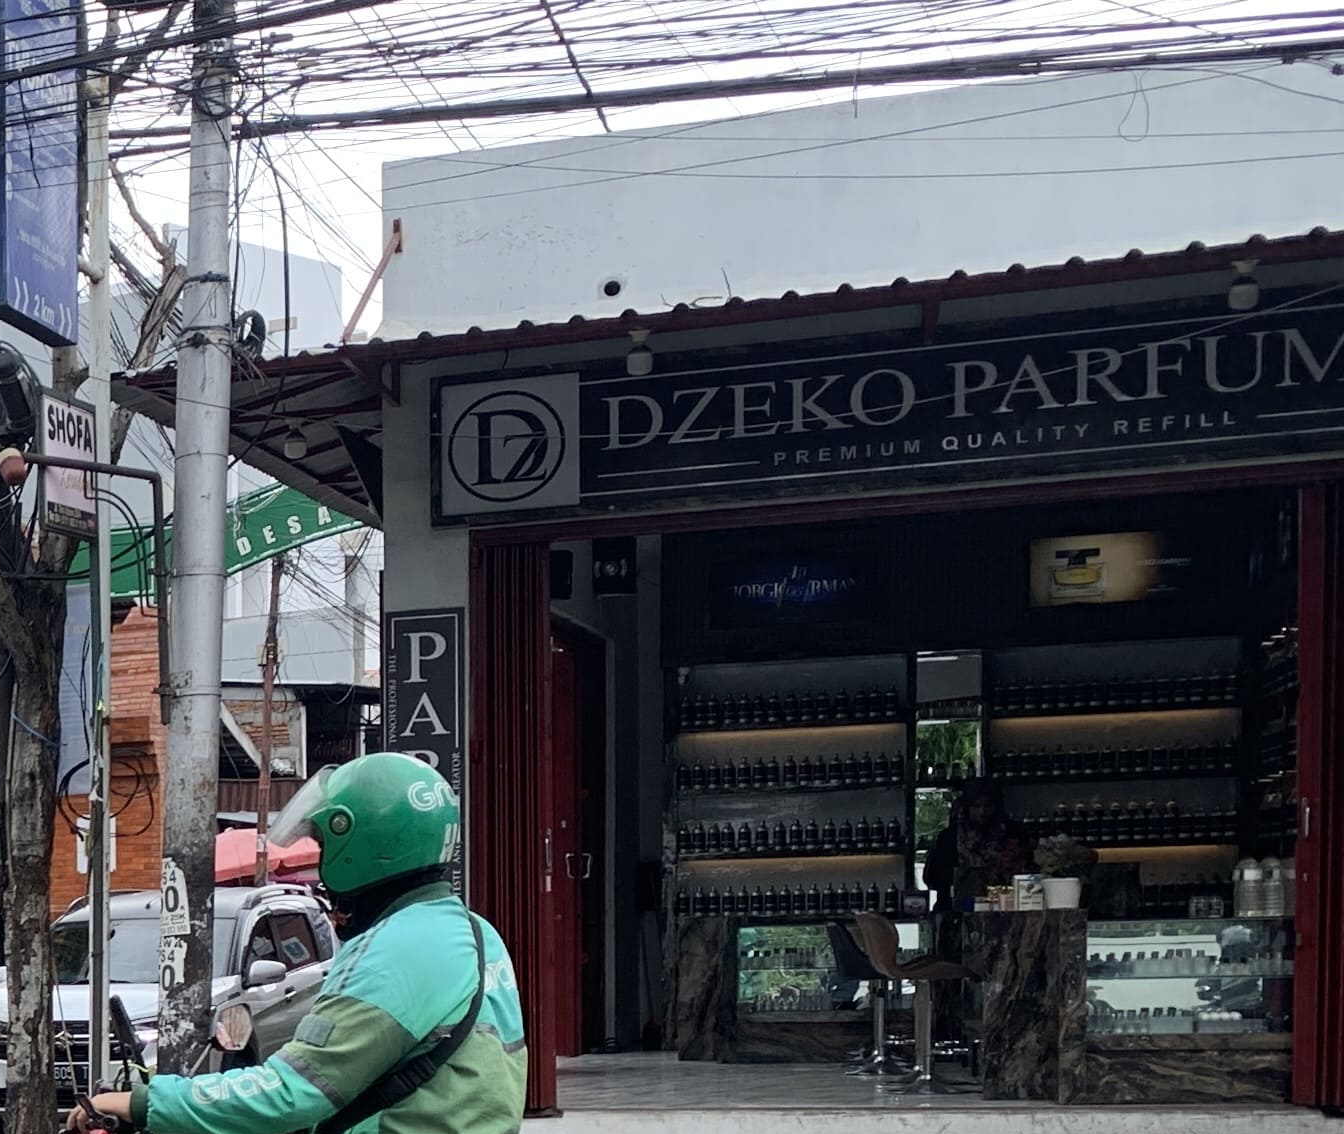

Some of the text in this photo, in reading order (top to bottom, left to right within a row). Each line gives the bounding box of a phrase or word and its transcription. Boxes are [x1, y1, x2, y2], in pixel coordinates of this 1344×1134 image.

[41, 297, 55, 325] km
[47, 404, 93, 453] SHOFA
[602, 369, 917, 452] DZEKO
[773, 410, 1238, 467] PREMIUM QUALITY REFILL
[235, 505, 334, 556] DESA
[452, 751, 462, 791] REATOR
[192, 1062, 283, 1104] Grab
